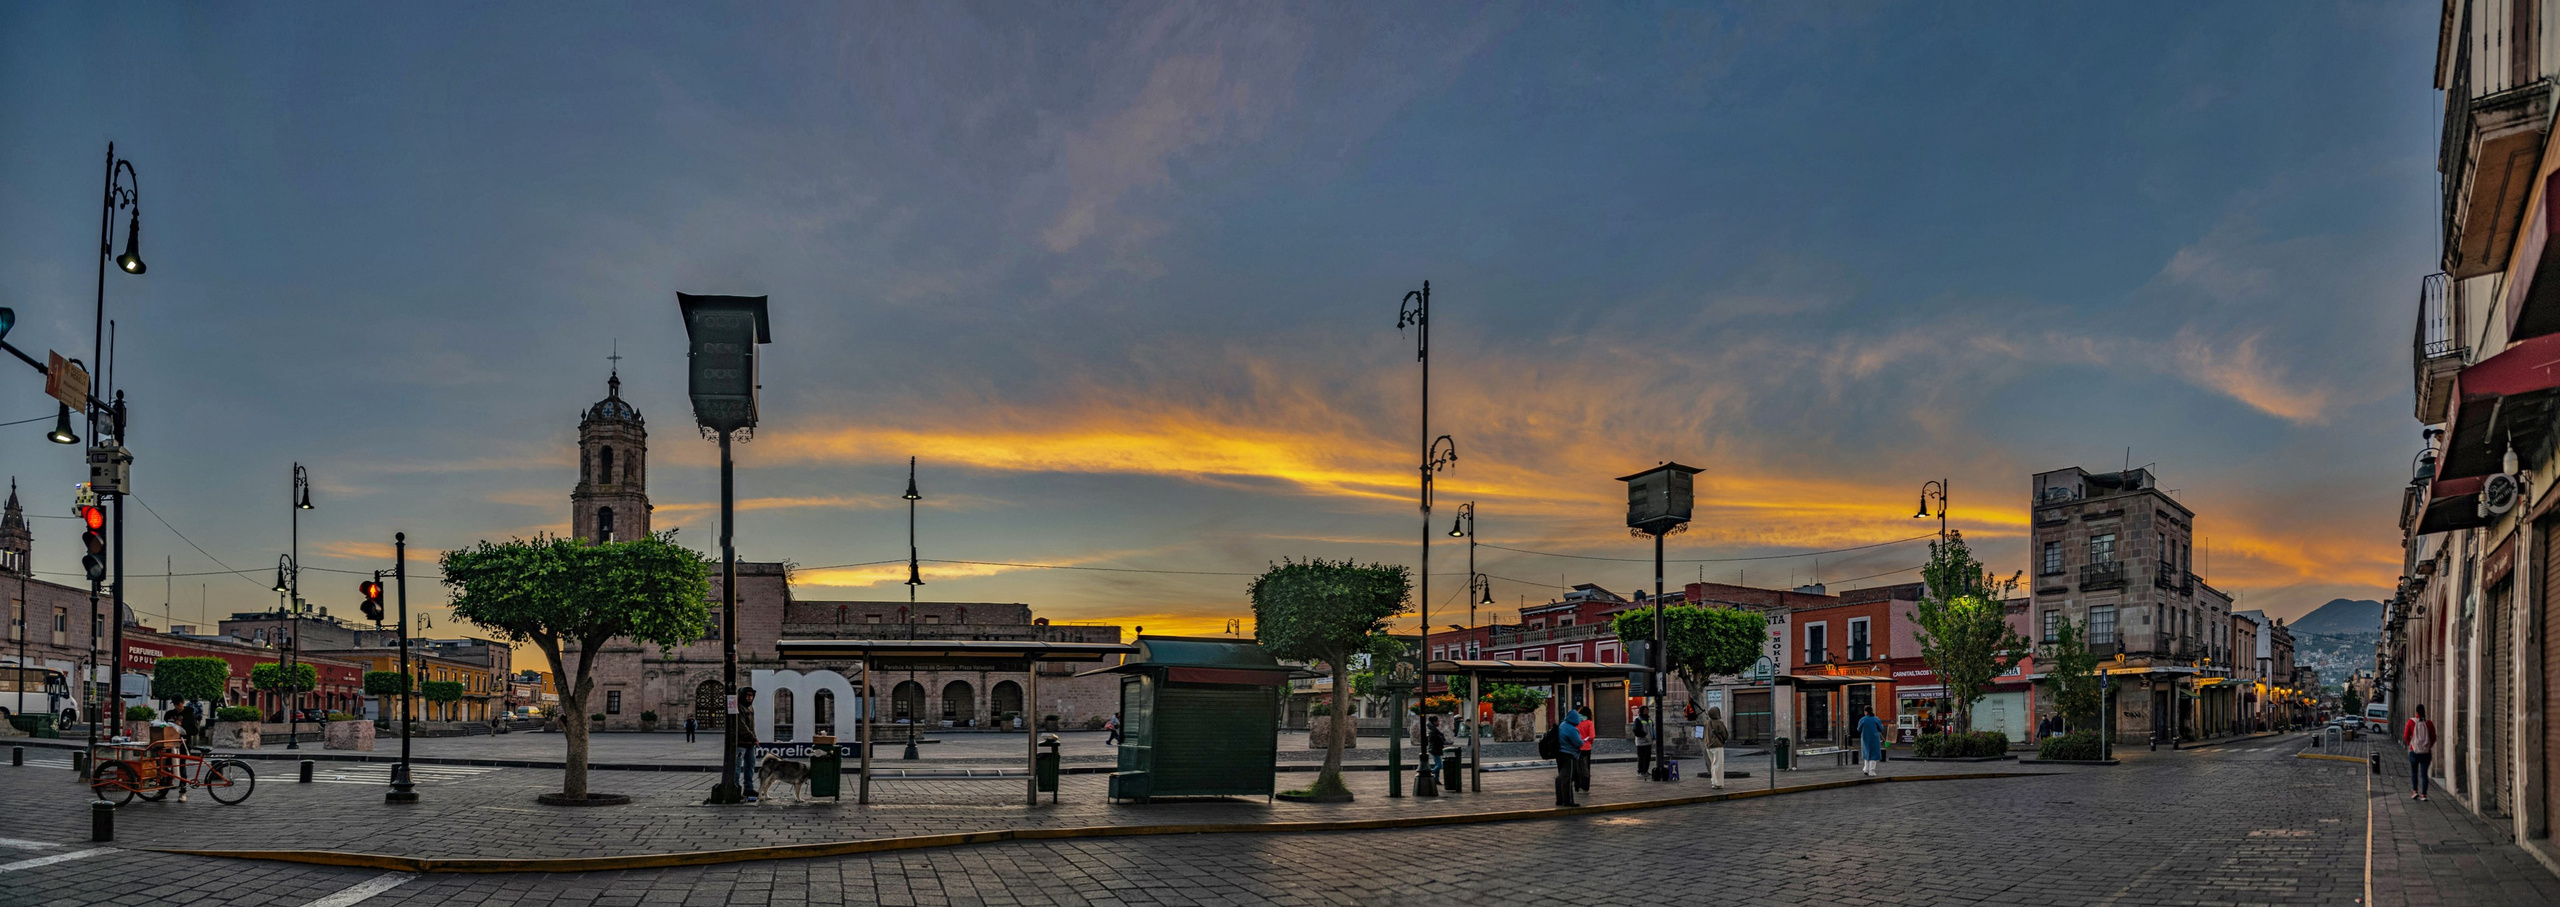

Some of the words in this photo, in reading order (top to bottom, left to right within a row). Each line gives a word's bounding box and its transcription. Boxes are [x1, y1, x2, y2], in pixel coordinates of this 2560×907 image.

[1766, 615, 1786, 625] NTA
[129, 646, 163, 657] PERFUMERIA
[1772, 630, 1781, 675] SMOKING
[751, 669, 855, 743] m
